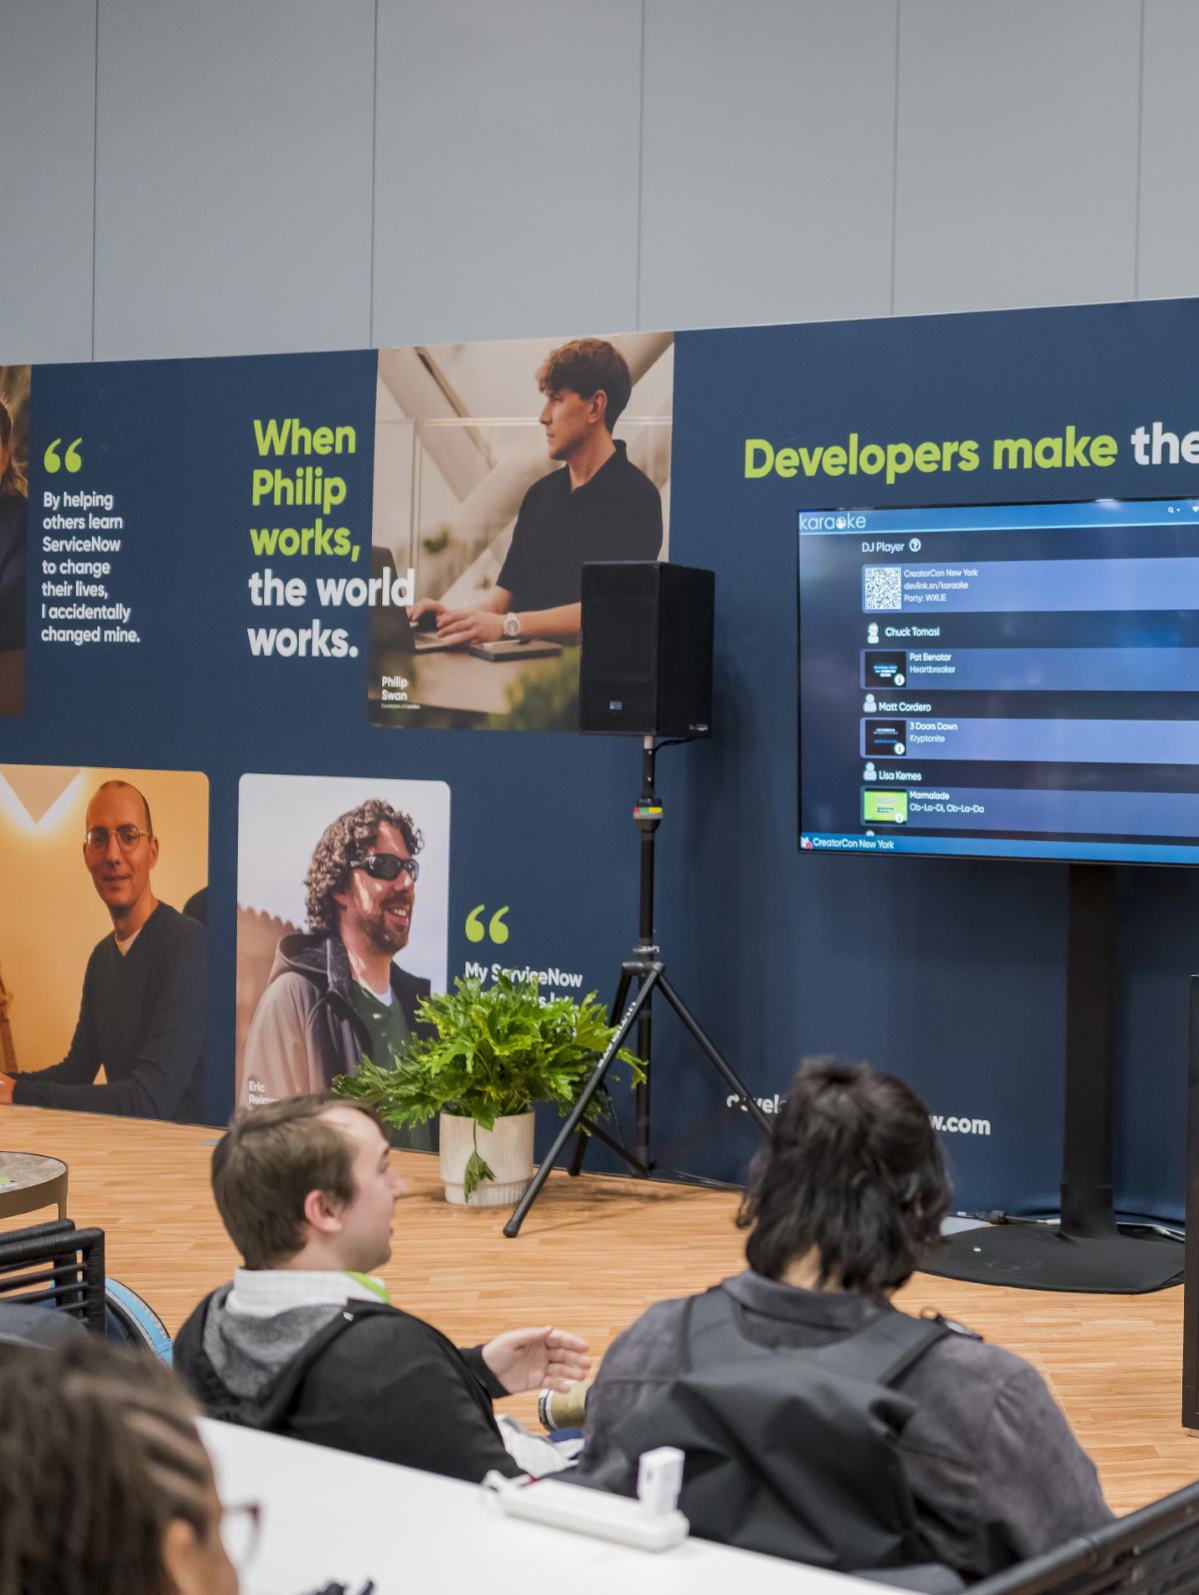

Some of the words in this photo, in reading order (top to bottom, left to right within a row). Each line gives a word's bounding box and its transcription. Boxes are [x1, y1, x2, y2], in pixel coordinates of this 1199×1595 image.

[253, 418, 356, 456] When
[744, 433, 979, 484] Developers
[993, 425, 1118, 470] make
[252, 466, 347, 515] Philip
[43, 491, 60, 510] By
[63, 491, 113, 511] helping
[43, 513, 85, 530] others
[89, 513, 123, 529] learn
[42, 536, 121, 552] ServiceNow
[250, 518, 360, 563] works,
[862, 542, 875, 553] DJ
[876, 541, 905, 555] Player
[42, 559, 56, 575] to
[59, 559, 111, 578] change
[904, 569, 945, 578] CreatorCon
[946, 569, 962, 577] New
[963, 569, 978, 577] York
[42, 581, 73, 597] their
[76, 581, 108, 600] lives,
[248, 568, 307, 607] the
[316, 566, 415, 607] world
[41, 603, 46, 619] I
[48, 603, 131, 623] accidentally
[41, 626, 100, 646] changed
[104, 626, 140, 643] mine.
[247, 618, 359, 658] works.
[885, 626, 911, 637] Chuck
[912, 626, 940, 637] Tomasi
[909, 652, 922, 661] Pat
[923, 652, 952, 661] Benatar
[909, 665, 956, 674] Heartbreaker
[382, 676, 408, 689] Philip
[381, 689, 408, 701] Swan
[879, 702, 898, 712] Matt
[899, 702, 932, 712] Cordero
[916, 722, 936, 730] Doors
[937, 722, 958, 731] Down
[909, 734, 945, 744] Kryptonite
[879, 770, 895, 781] Lisa
[909, 791, 950, 800] Marmalade
[812, 837, 858, 848] CreatorCon
[859, 839, 876, 849] New
[877, 839, 895, 850] York
[465, 961, 488, 984] My
[491, 963, 583, 988] ServiceNow
